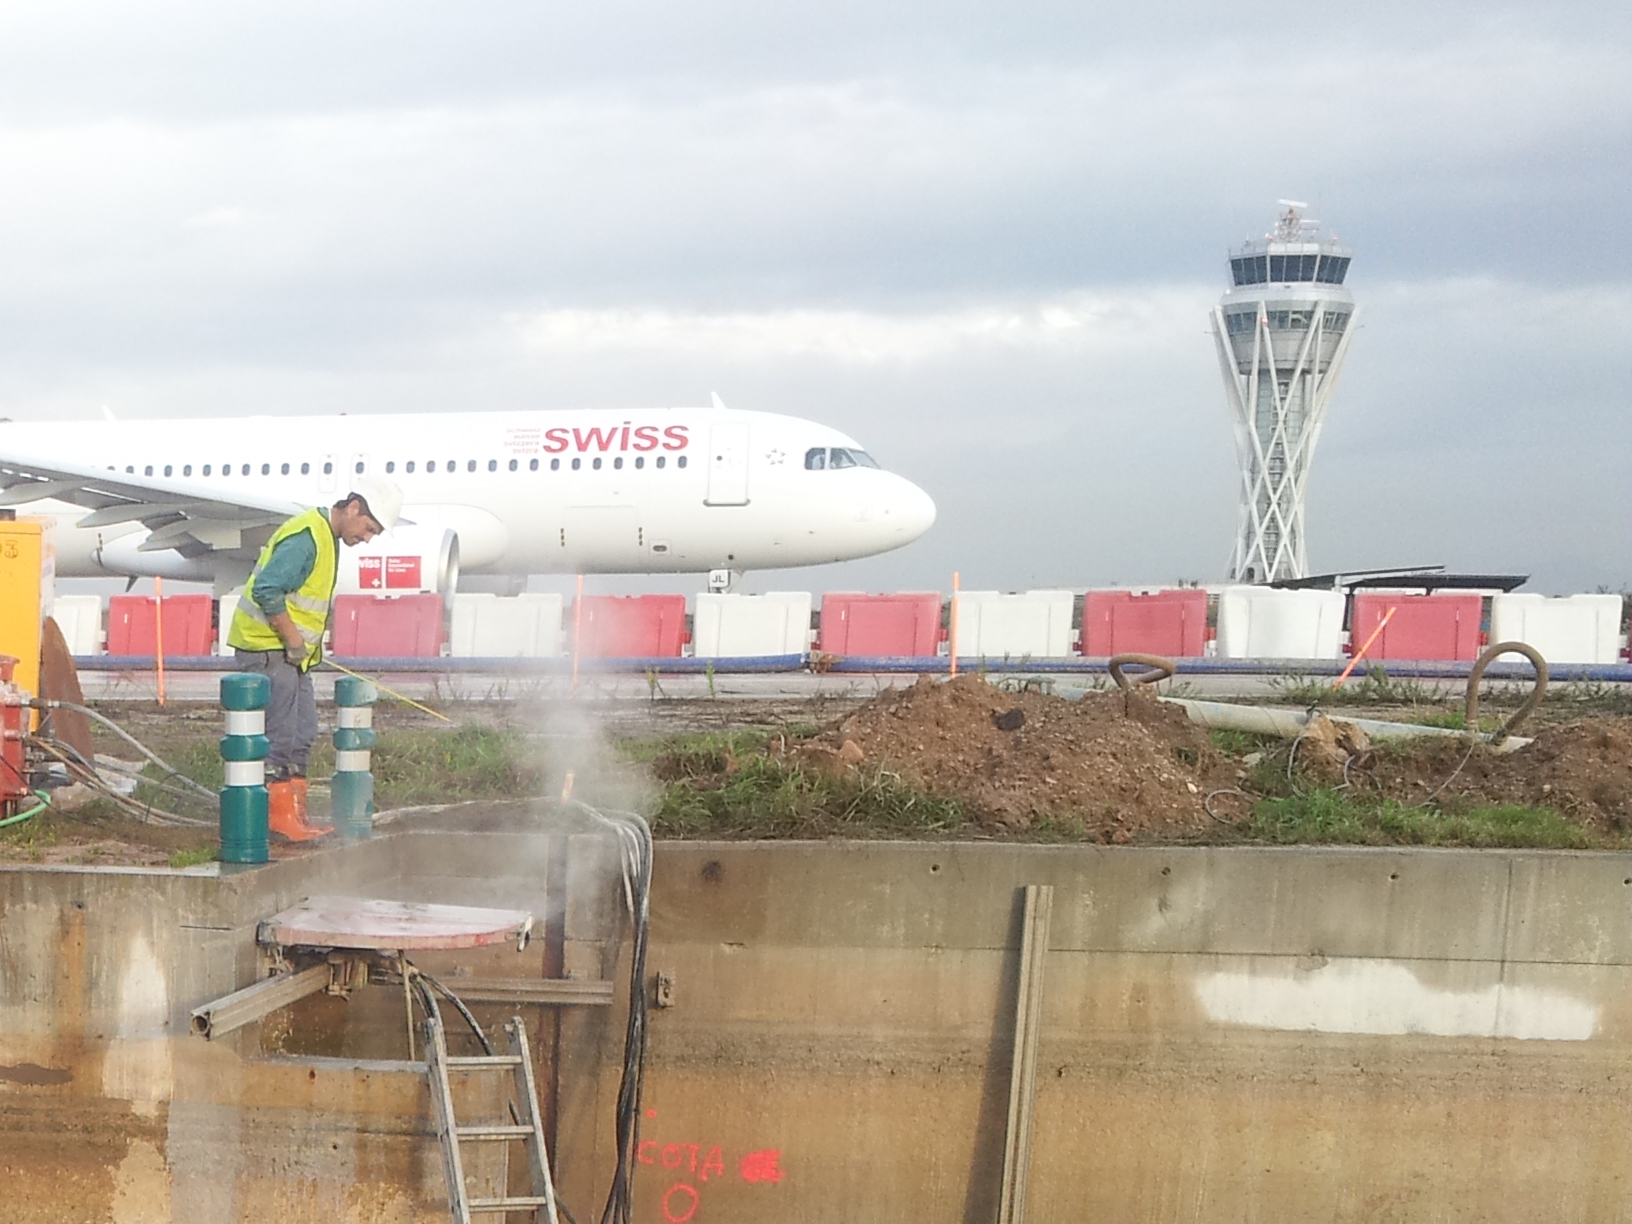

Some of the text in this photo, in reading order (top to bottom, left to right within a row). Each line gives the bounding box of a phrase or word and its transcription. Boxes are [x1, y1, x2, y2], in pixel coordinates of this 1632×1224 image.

[543, 421, 690, 453] swiss
[712, 575, 724, 583] JL
[637, 1140, 725, 1182] COTA
